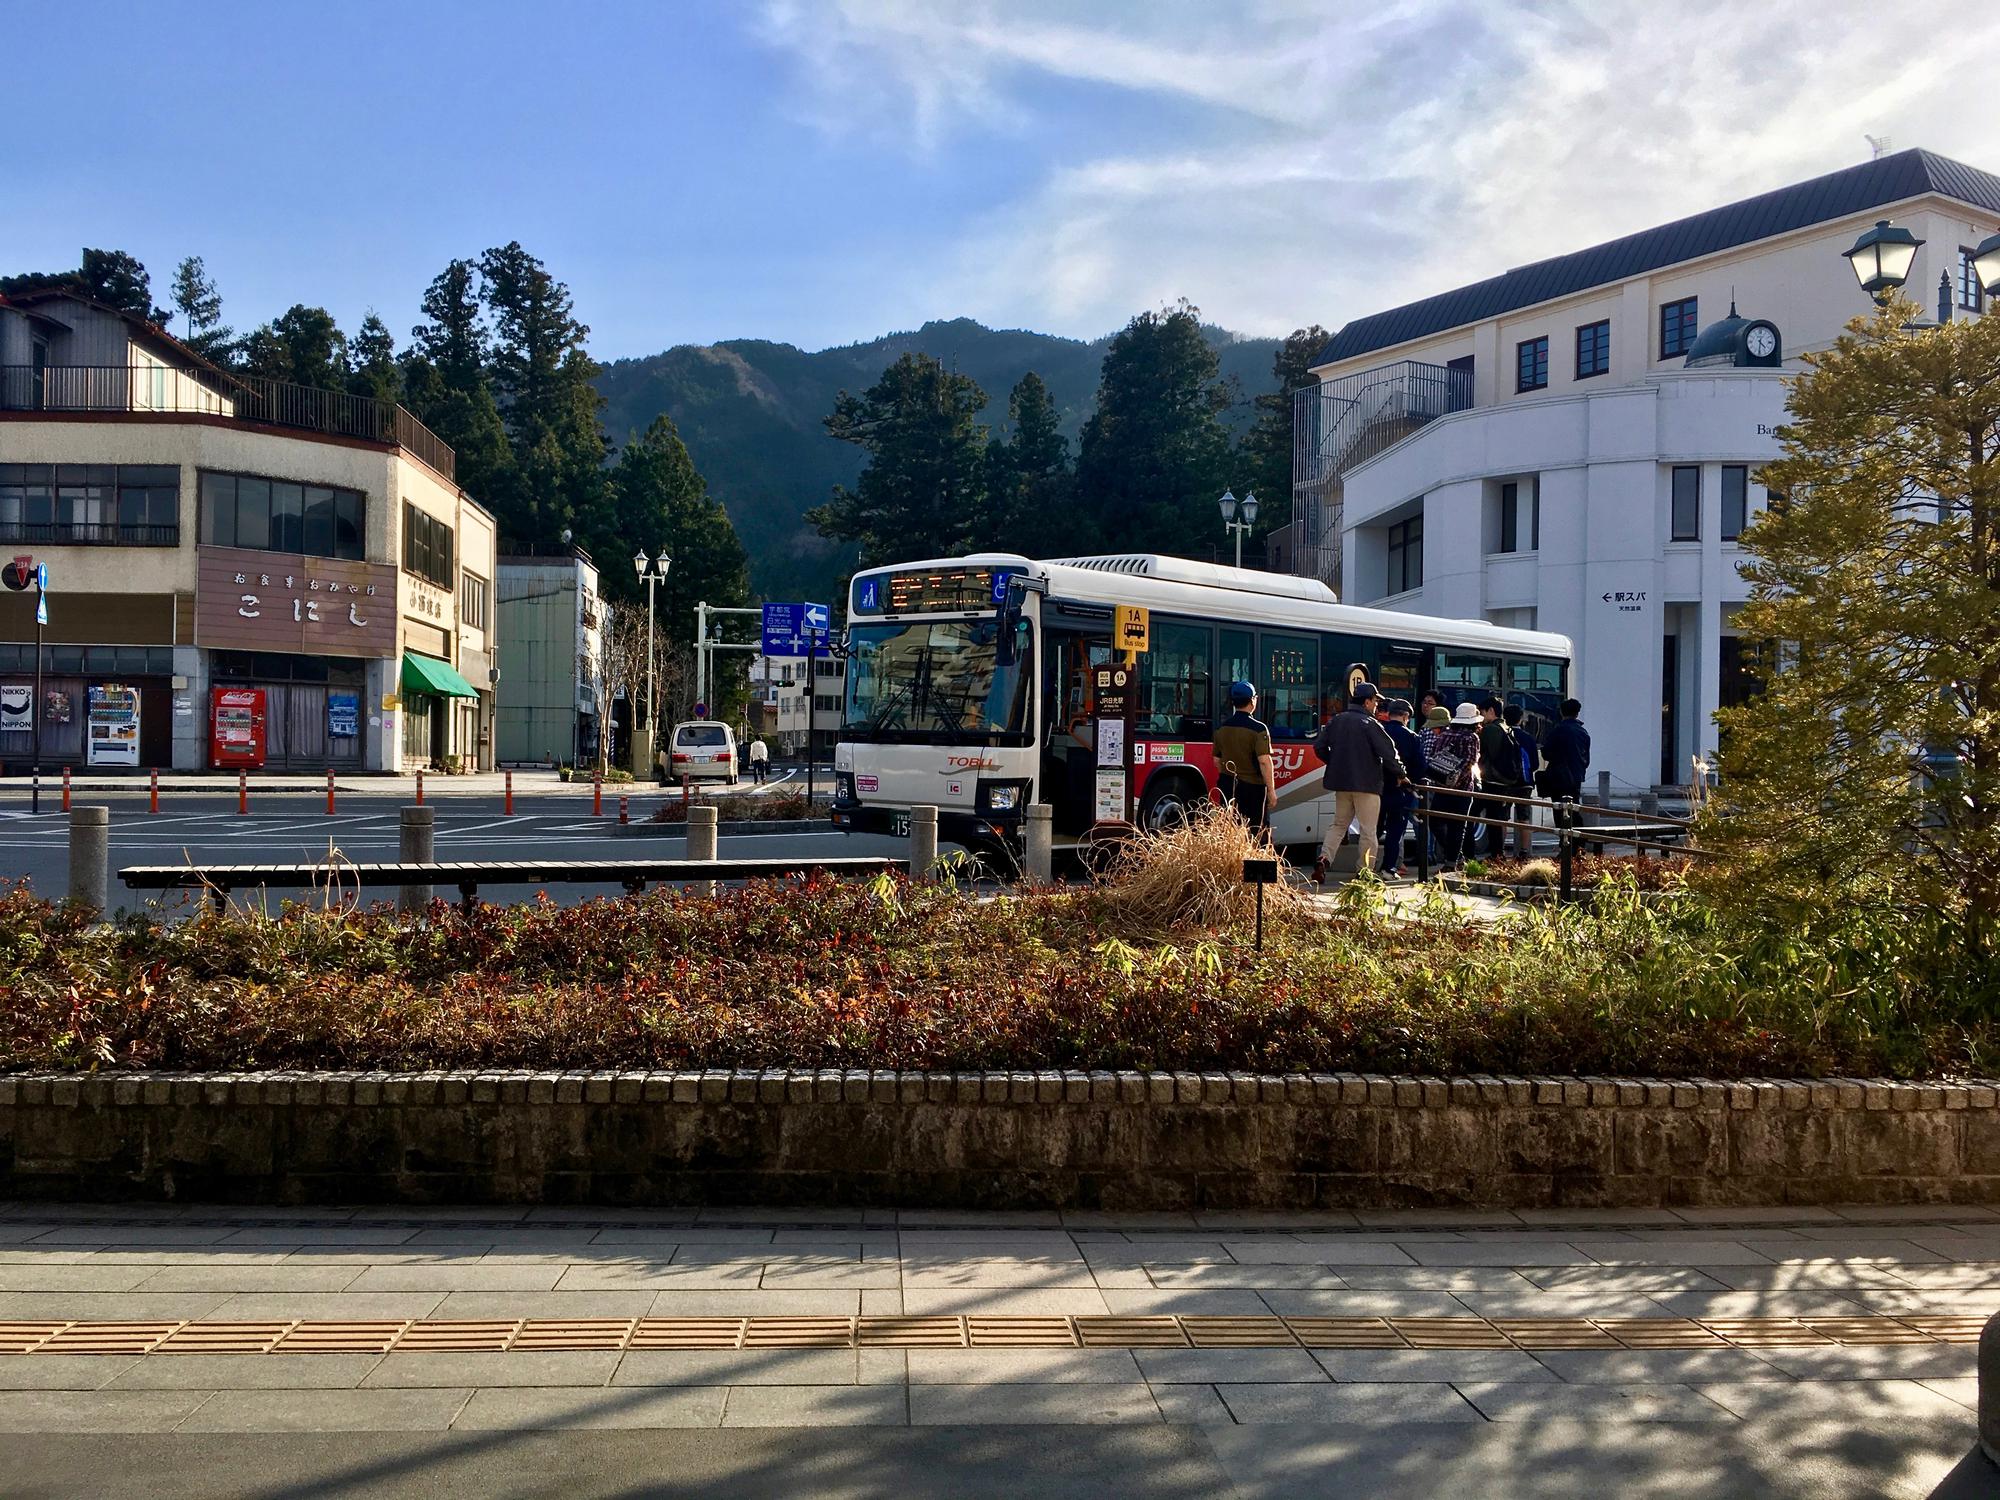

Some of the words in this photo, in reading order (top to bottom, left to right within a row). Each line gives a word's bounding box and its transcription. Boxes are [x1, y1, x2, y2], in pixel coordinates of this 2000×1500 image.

[1615, 592, 1646, 602] 駅スパ
[238, 594, 368, 627] こにし
[1128, 609, 1141, 622] 1A
[947, 757, 993, 768] TOBU
